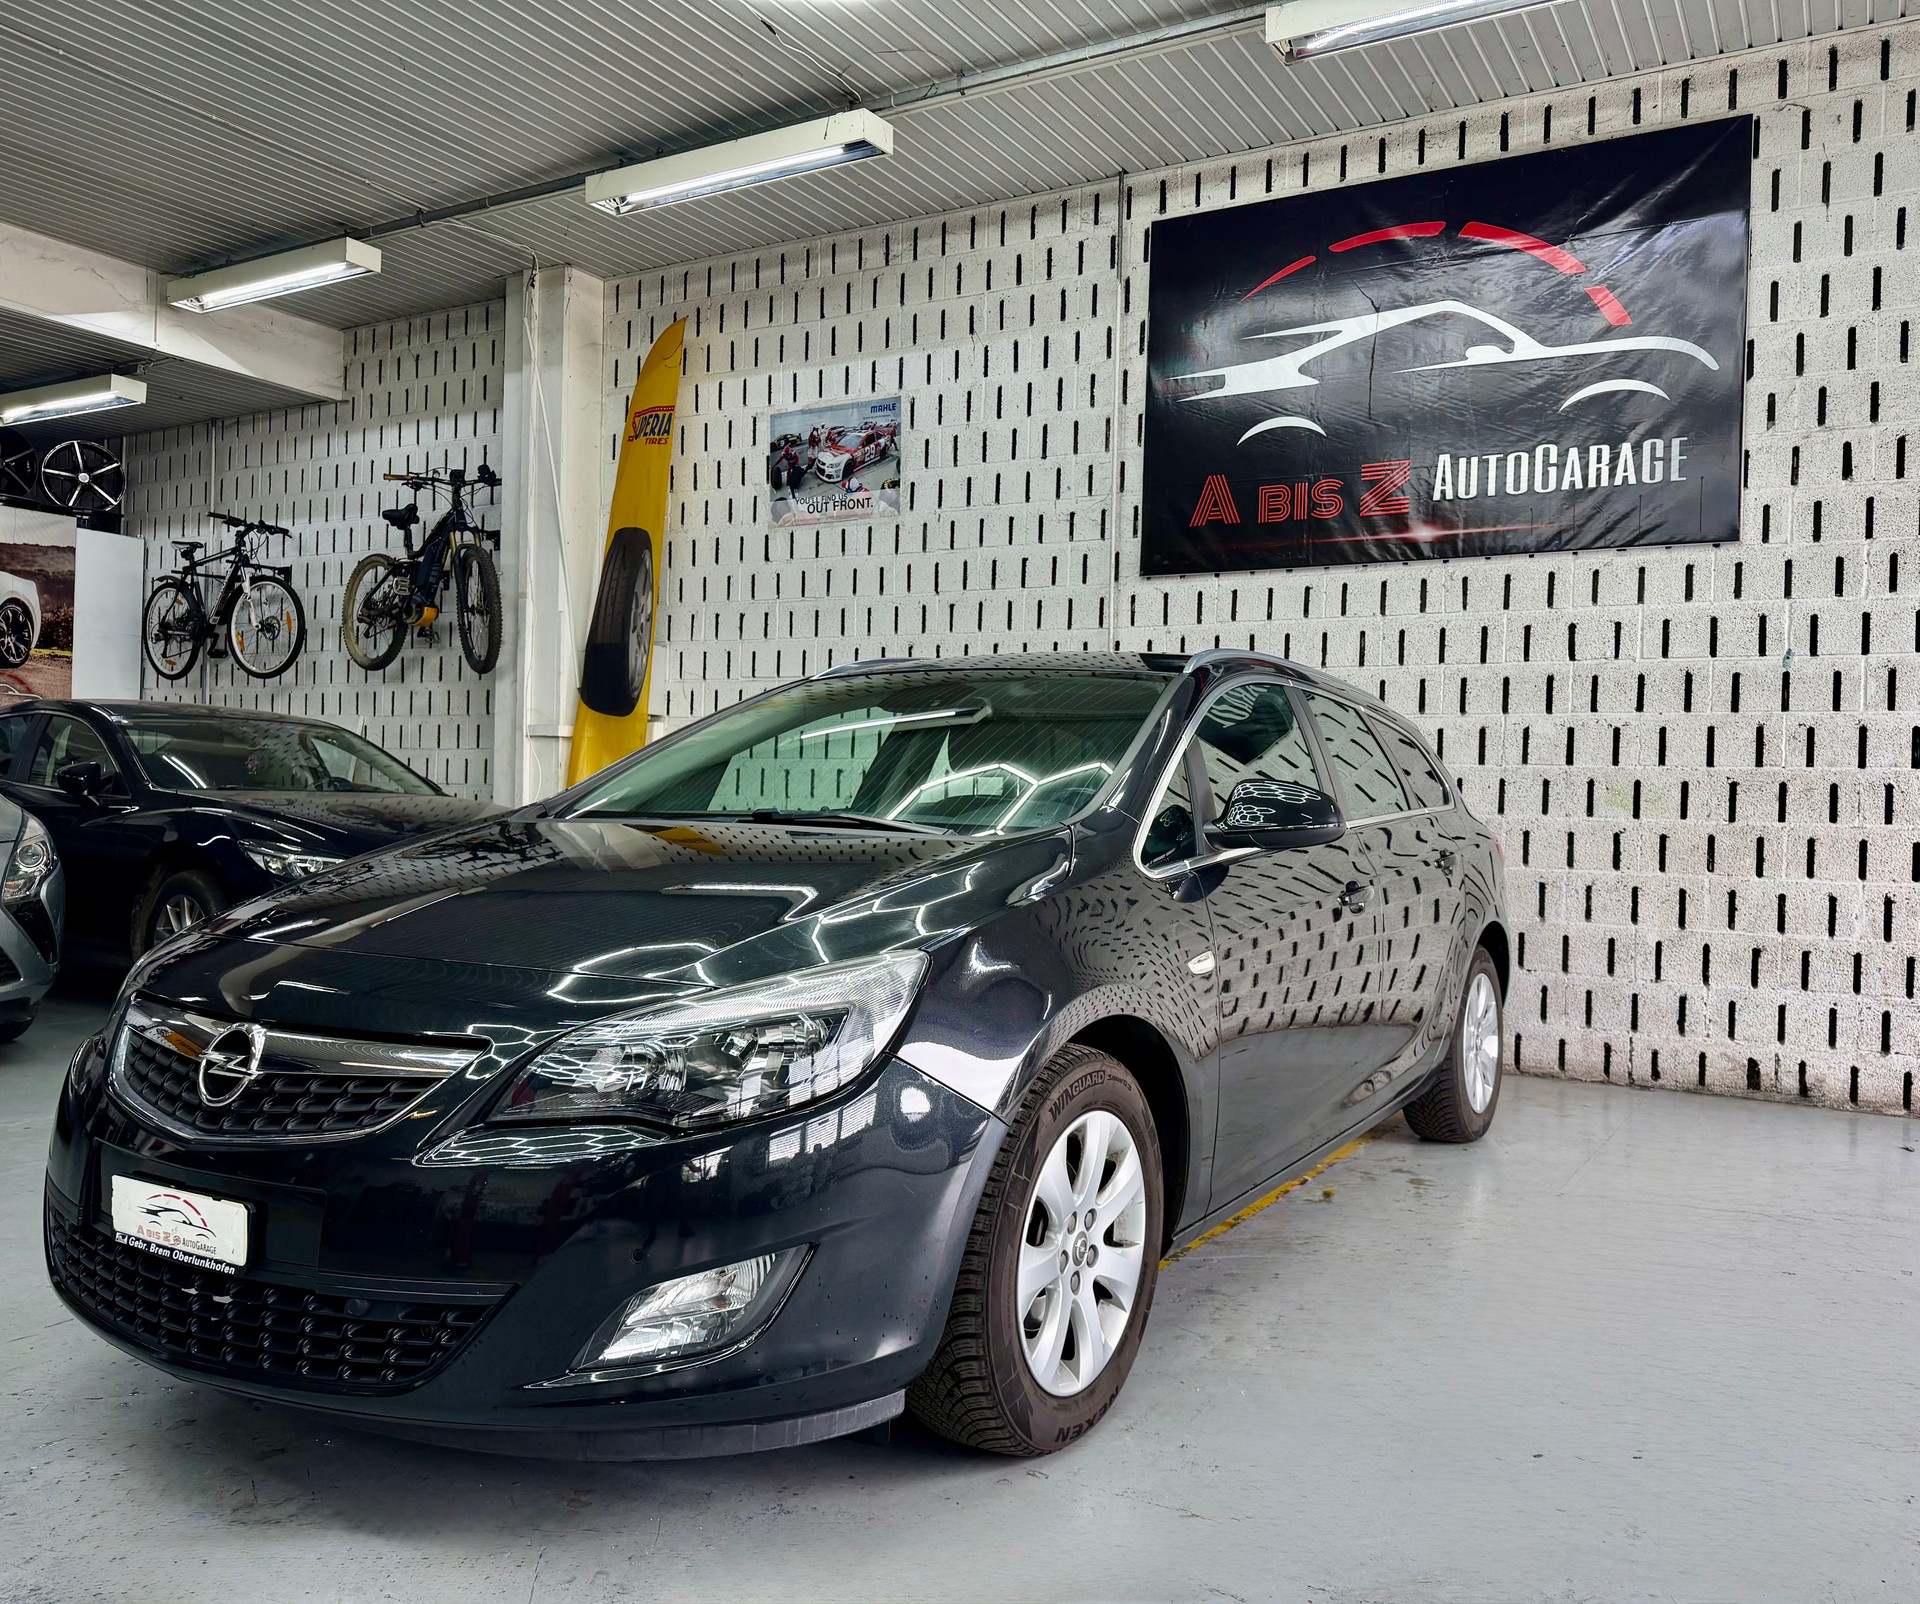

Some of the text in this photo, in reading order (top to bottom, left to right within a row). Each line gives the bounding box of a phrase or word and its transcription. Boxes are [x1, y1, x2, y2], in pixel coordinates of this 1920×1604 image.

[870, 403, 897, 413] MAHLE
[645, 437, 669, 445] TIRES
[865, 444, 876, 461] 29
[1190, 437, 1689, 527] A BIS Z AUTOGARAGE
[807, 497, 874, 514] OUT FRONT.
[822, 494, 837, 502] FIND
[839, 493, 848, 501] US
[1048, 1070, 1106, 1122] WINGUARD
[136, 1225, 145, 1235] A
[129, 1236, 236, 1275] Gebr. Brem Oberlunkhofen
[1055, 1385, 1119, 1443] NEXEN
